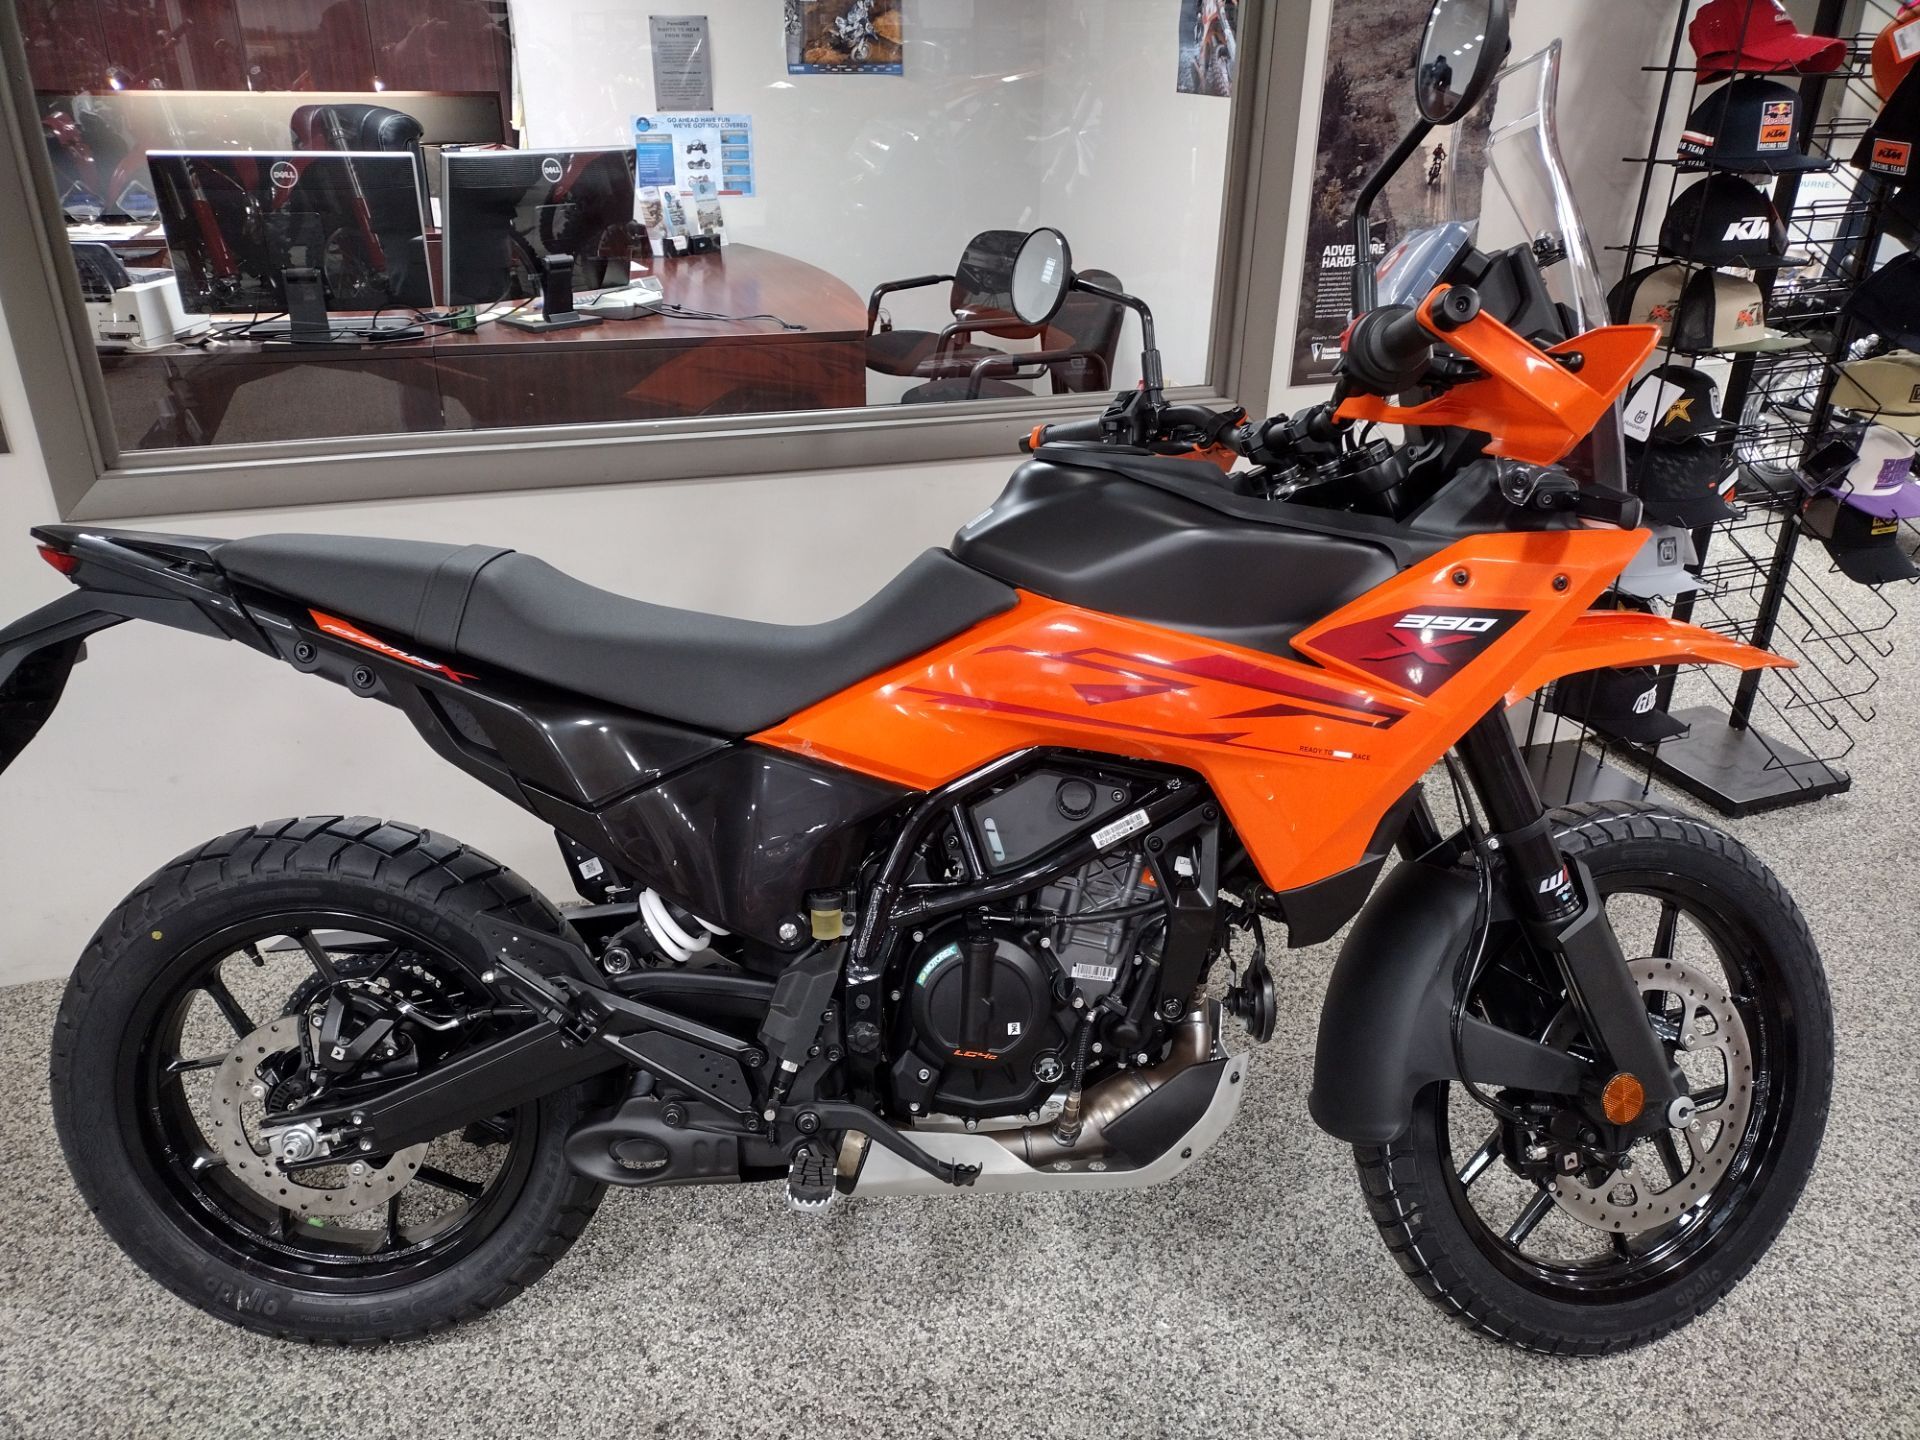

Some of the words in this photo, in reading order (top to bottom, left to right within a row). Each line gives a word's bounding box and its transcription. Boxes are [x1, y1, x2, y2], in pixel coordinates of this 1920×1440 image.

[1765, 128, 1786, 139] KTM
[1688, 145, 1705, 156] TEAM
[1877, 147, 1903, 160] KTM
[545, 166, 560, 174] DELL
[1872, 162, 1889, 171] RACING
[1890, 164, 1905, 174] TEAM
[273, 171, 295, 179] DELL
[1323, 243, 1386, 256] ADVERE
[1321, 256, 1357, 268] HARDE
[1393, 614, 1499, 632] 390
[322, 624, 443, 669] ADVENTURE
[1299, 745, 1322, 755] READY
[1324, 748, 1333, 756] TO
[1352, 752, 1371, 761] RACE
[925, 944, 957, 973] MOTOREX
